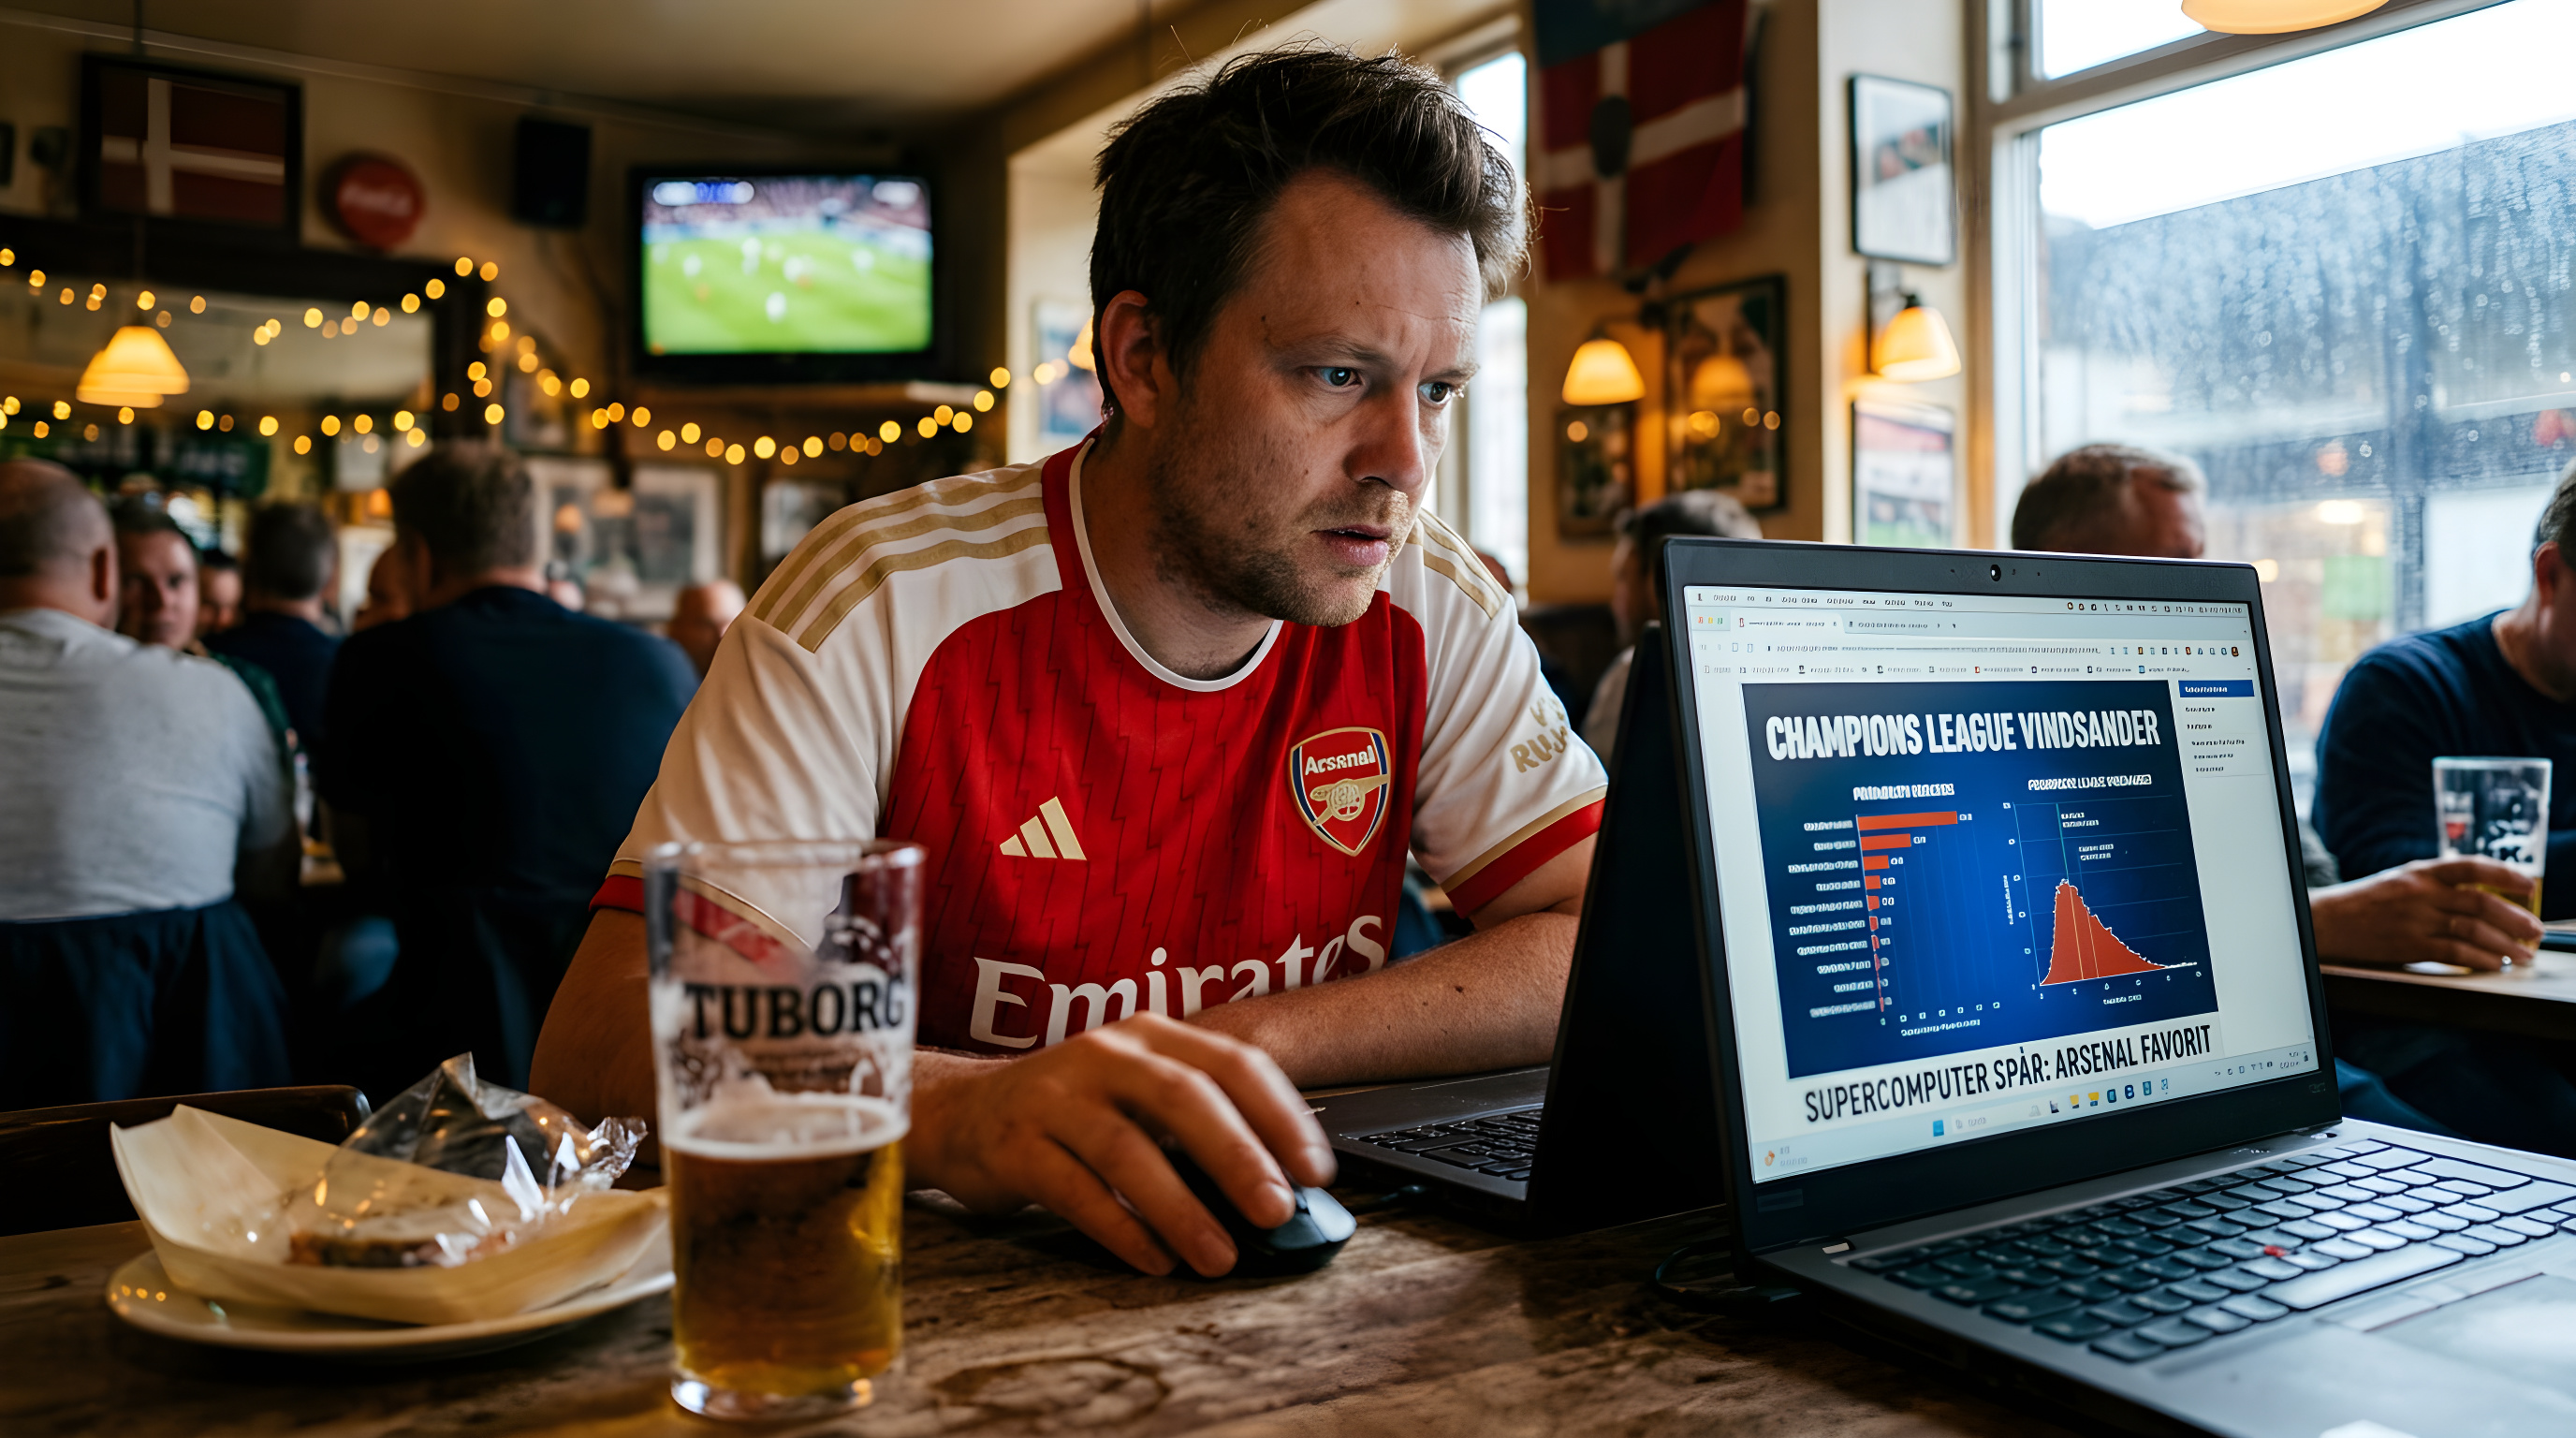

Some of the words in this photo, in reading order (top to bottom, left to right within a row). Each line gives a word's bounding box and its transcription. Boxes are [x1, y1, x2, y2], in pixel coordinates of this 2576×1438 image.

[1765, 713, 1923, 761] CHAMPIONS
[1925, 712, 2017, 754] LEAGUE
[2017, 709, 2161, 750] VINDSANDER
[684, 978, 904, 1040] TUBORG
[969, 915, 1386, 1049] Emirates
[1805, 1062, 1990, 1123] SUPERCOMPUTER
[2056, 1037, 2138, 1079] ARSENAL
[2140, 1024, 2211, 1064] FAVORIT
